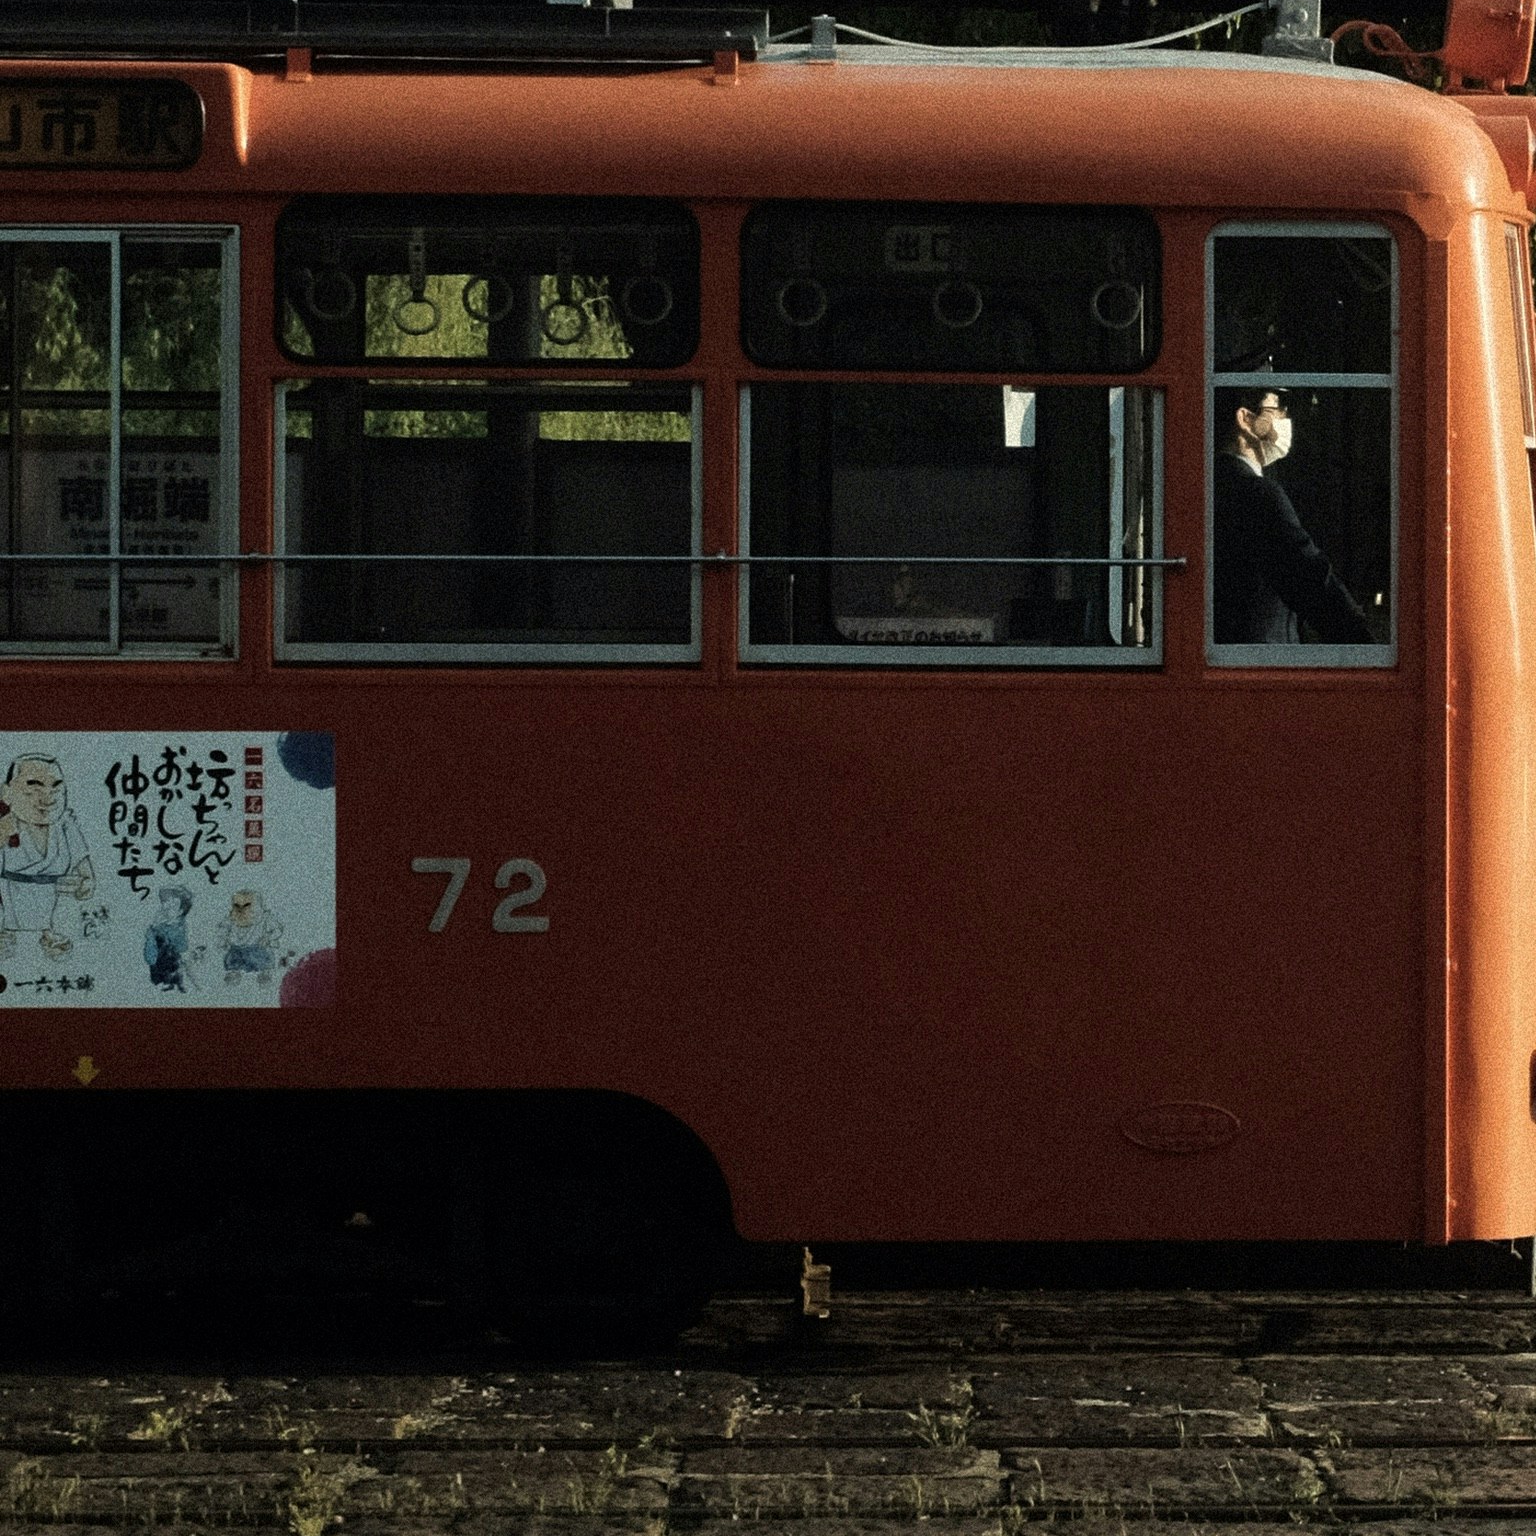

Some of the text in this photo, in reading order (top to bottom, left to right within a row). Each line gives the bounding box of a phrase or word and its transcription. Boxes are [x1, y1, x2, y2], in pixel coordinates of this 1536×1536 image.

[104, 754, 155, 901] 仲間たち
[153, 745, 187, 875] おかしな
[186, 749, 237, 885] 坊っちゃんと
[411, 857, 551, 934] 72
